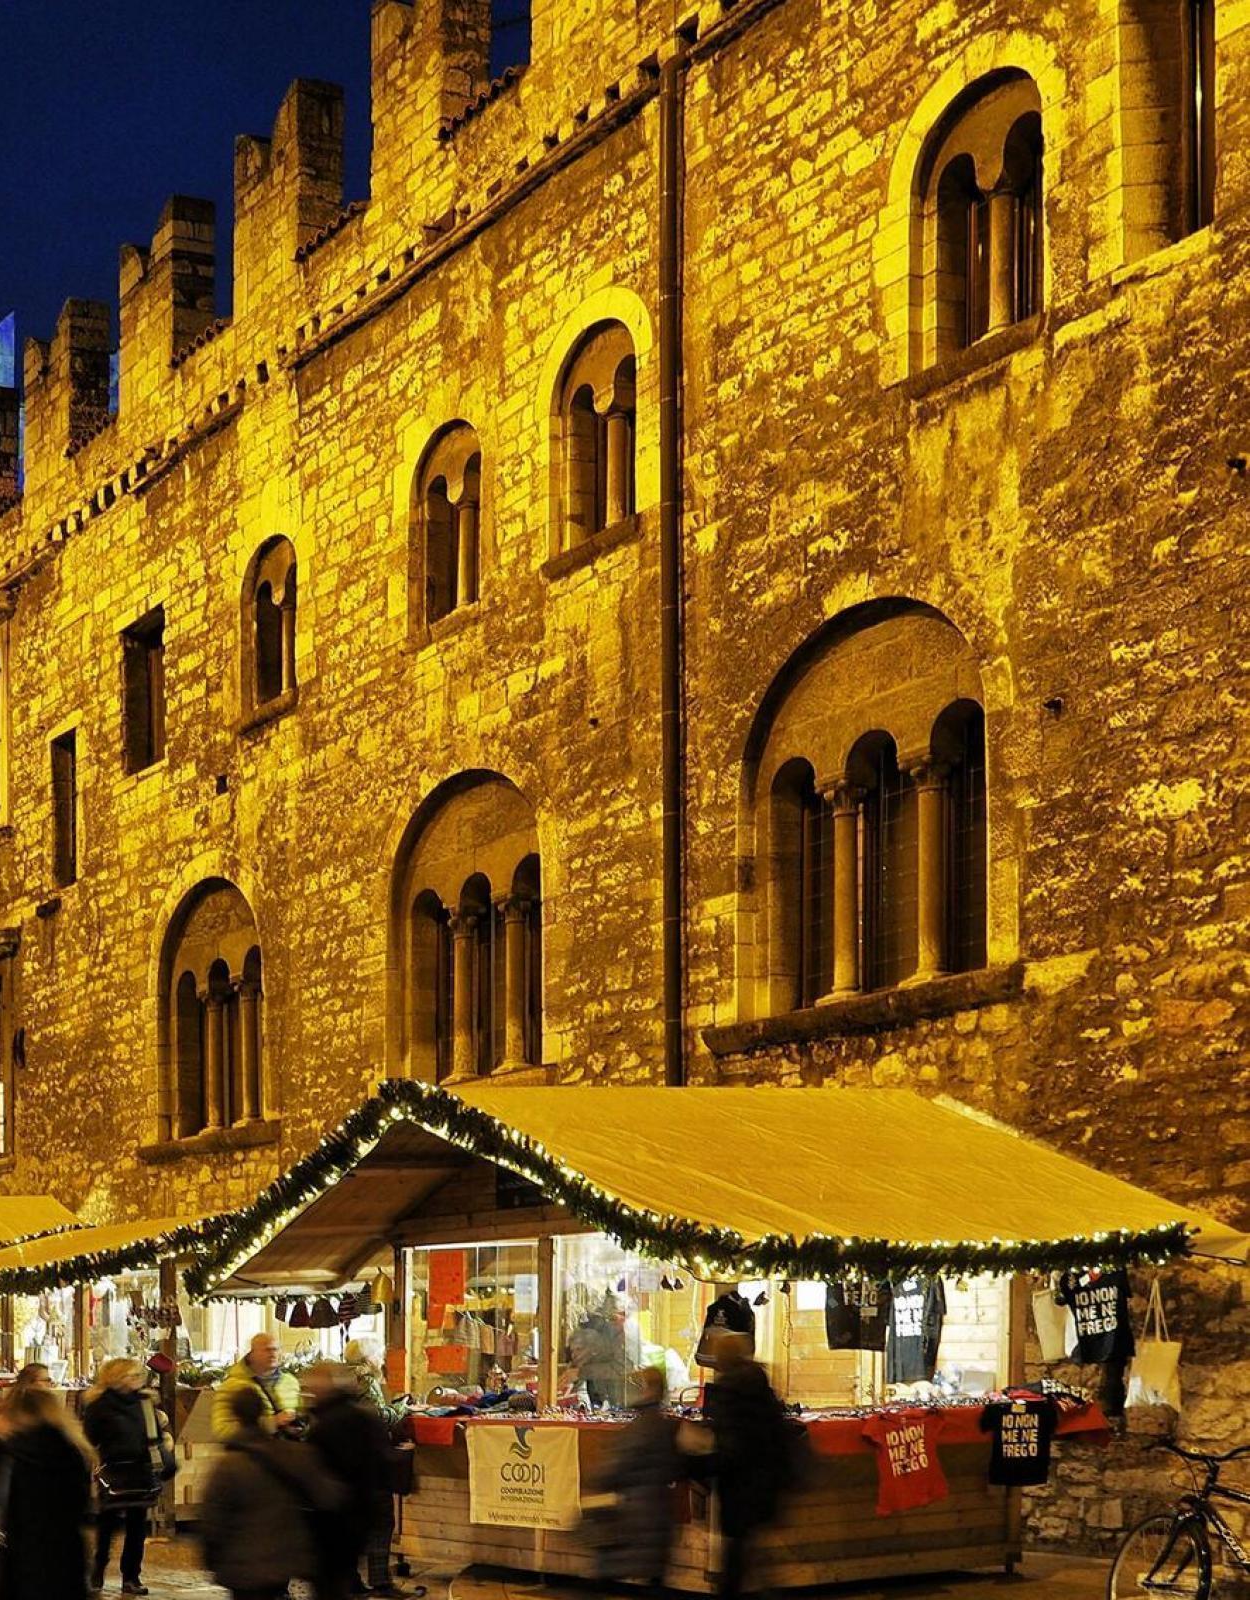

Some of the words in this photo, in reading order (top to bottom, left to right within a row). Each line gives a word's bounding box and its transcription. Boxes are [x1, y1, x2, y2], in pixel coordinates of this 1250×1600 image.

[1075, 1292, 1089, 1306] IO
[1090, 1286, 1118, 1303] NON
[1076, 1305, 1097, 1320] ME
[1101, 1301, 1117, 1317] NE
[1078, 1316, 1118, 1336] FREGO
[1002, 1415, 1013, 1428] IO
[1015, 1414, 1038, 1428] NON
[886, 1432, 899, 1446] IO
[1001, 1429, 1019, 1442] ME
[1021, 1429, 1038, 1442] NE
[889, 1445, 906, 1462] ME
[910, 1438, 925, 1455] NE
[1002, 1443, 1037, 1457] FREGO
